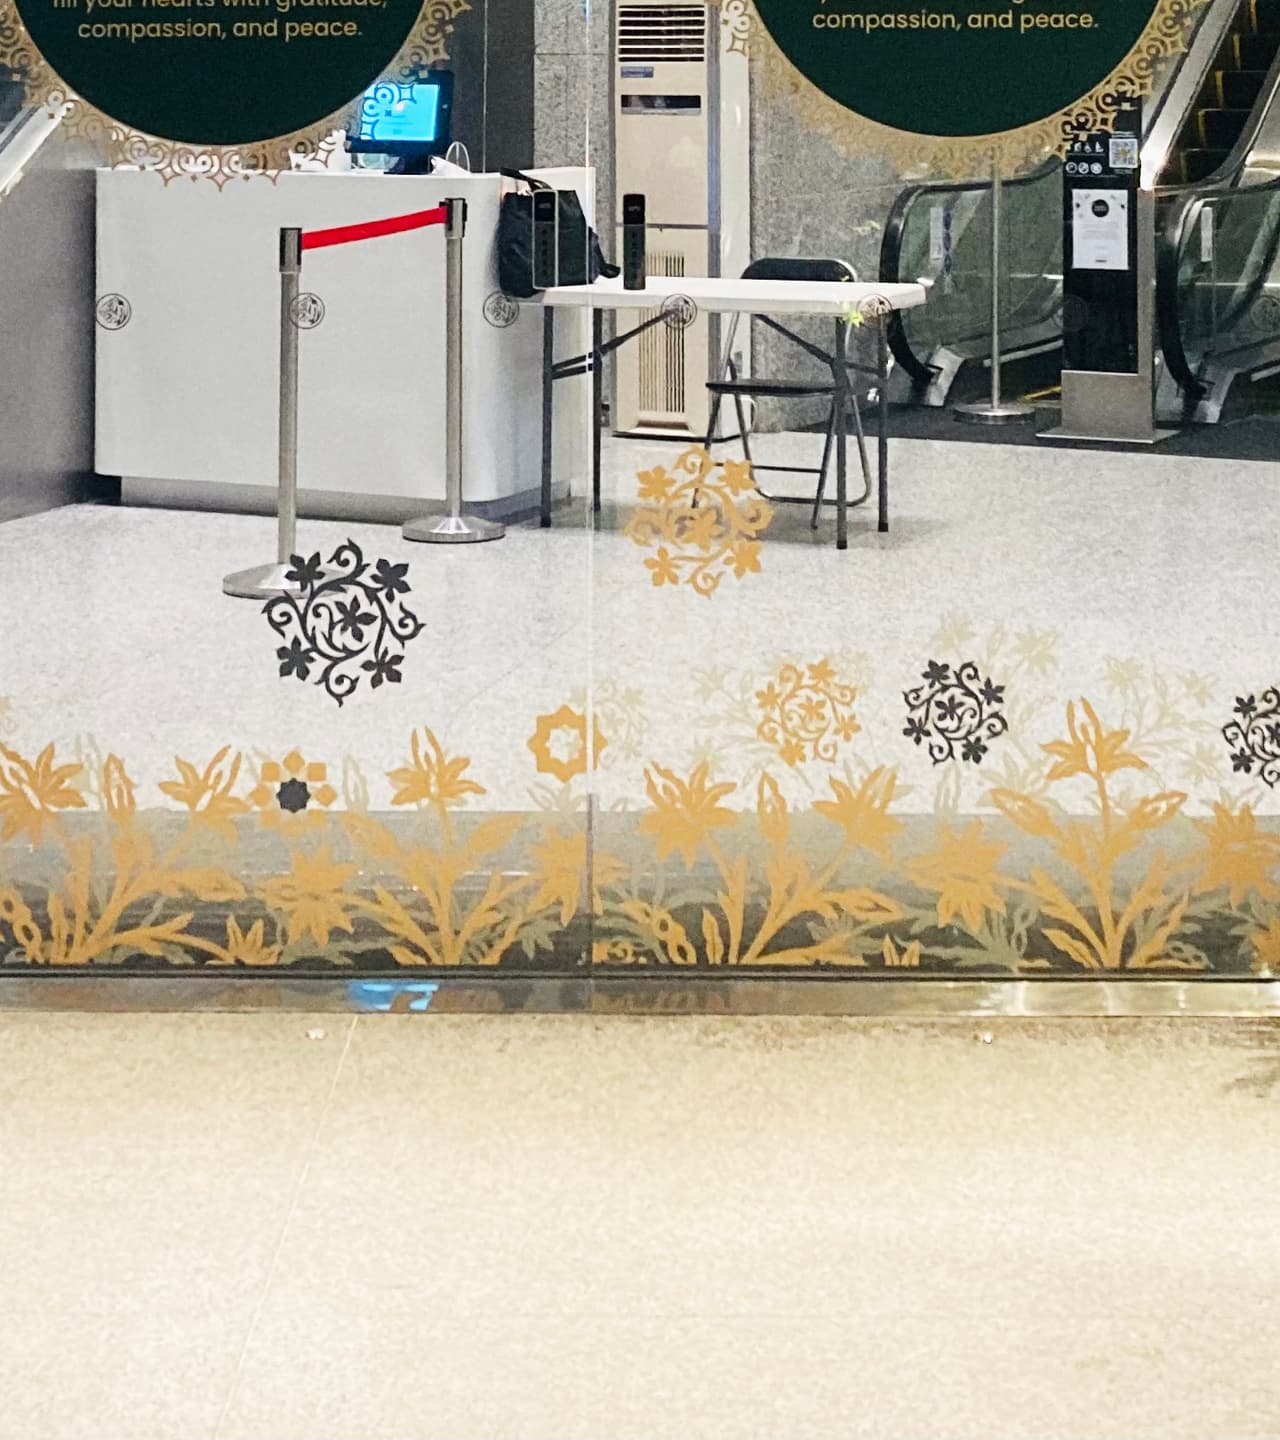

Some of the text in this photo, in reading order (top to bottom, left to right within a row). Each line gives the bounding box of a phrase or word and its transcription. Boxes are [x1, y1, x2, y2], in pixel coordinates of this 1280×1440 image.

[78, 18, 362, 43] compassion, and peace.
[812, 9, 1099, 34] compassion, and peace.
